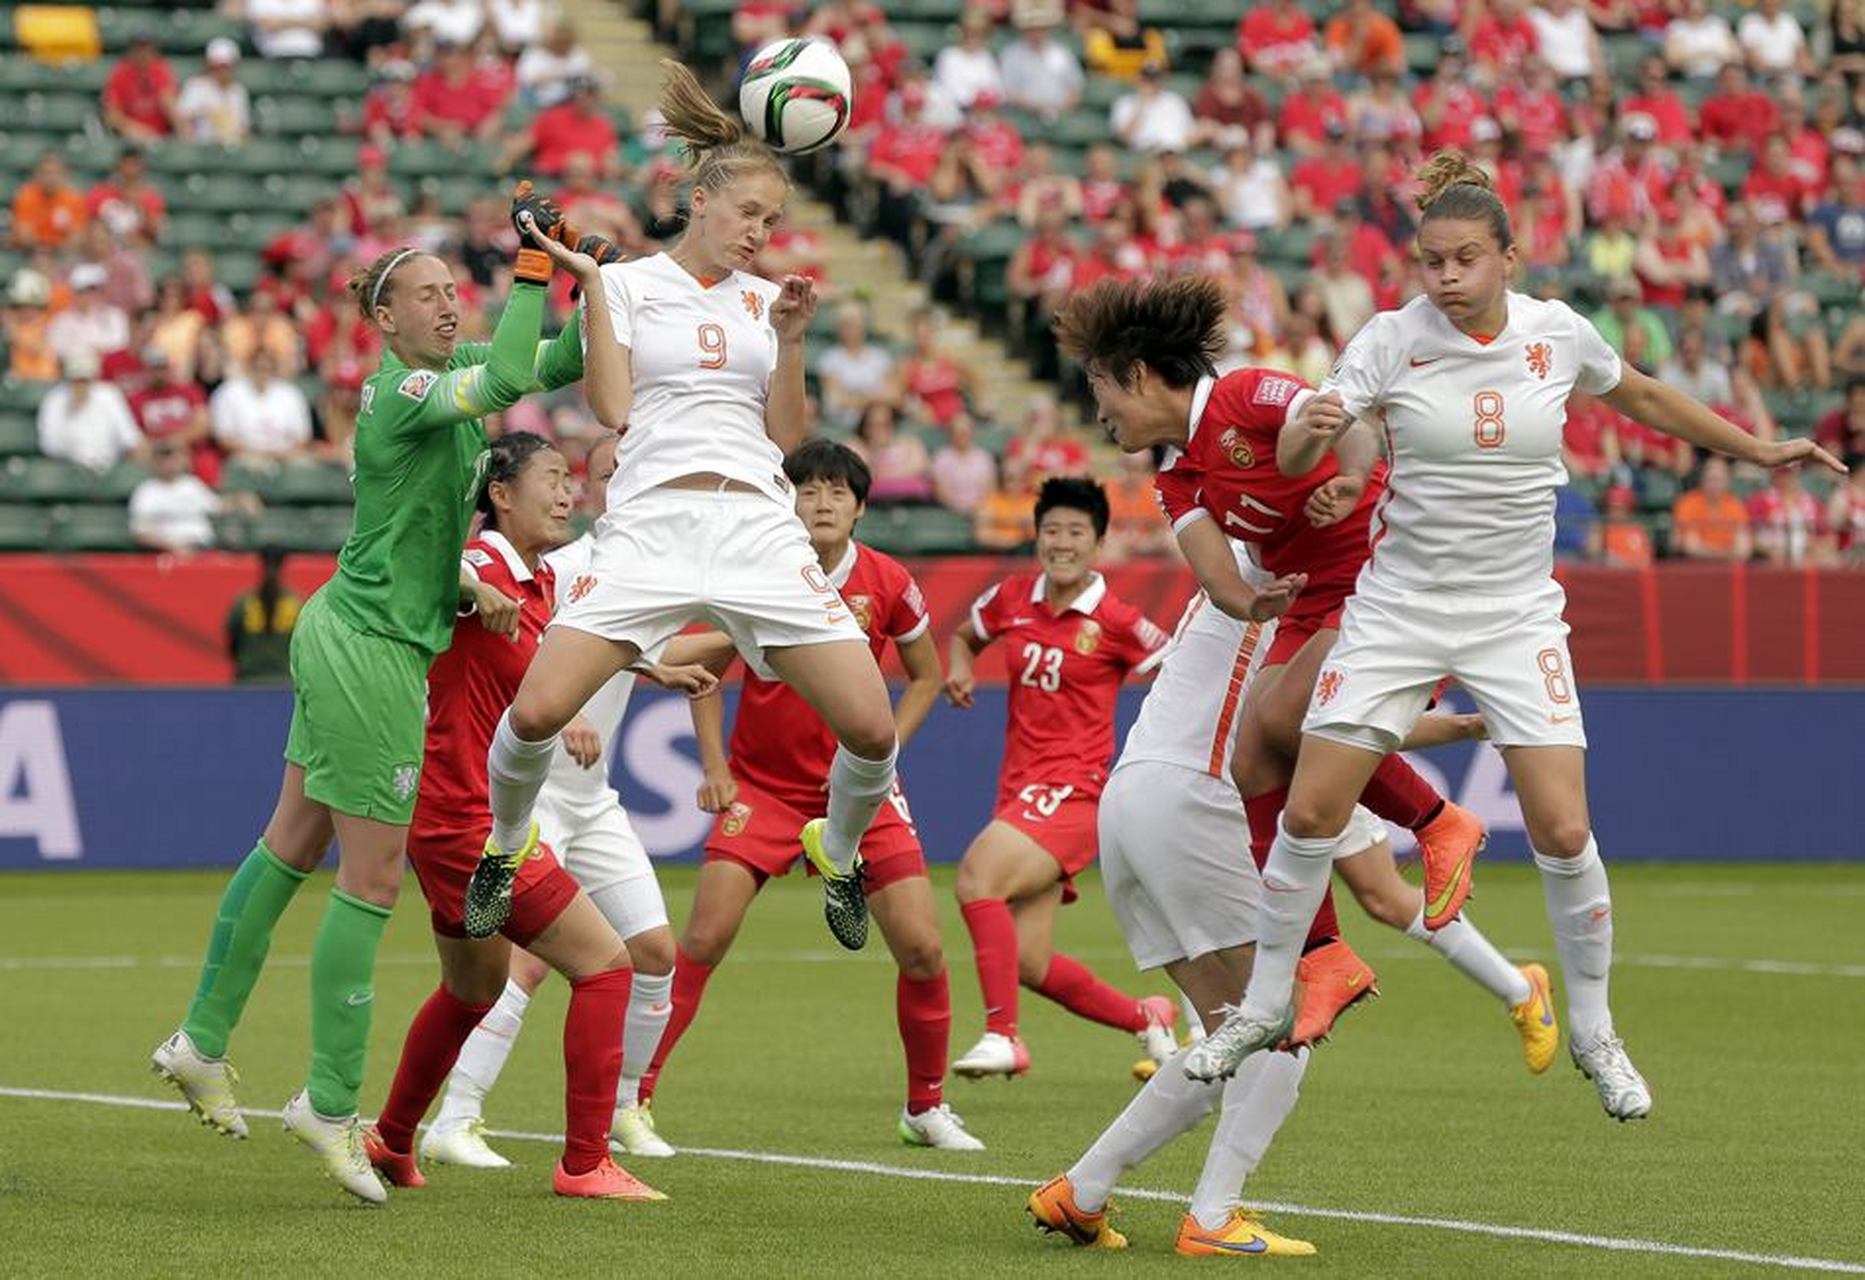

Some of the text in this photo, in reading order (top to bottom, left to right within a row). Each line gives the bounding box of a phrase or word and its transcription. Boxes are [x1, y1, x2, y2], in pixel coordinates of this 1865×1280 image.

[698, 323, 727, 370] 9
[1474, 391, 1505, 448] 8
[1224, 493, 1285, 534] 11
[1020, 642, 1065, 692] 23
[1537, 647, 1571, 704] 8
